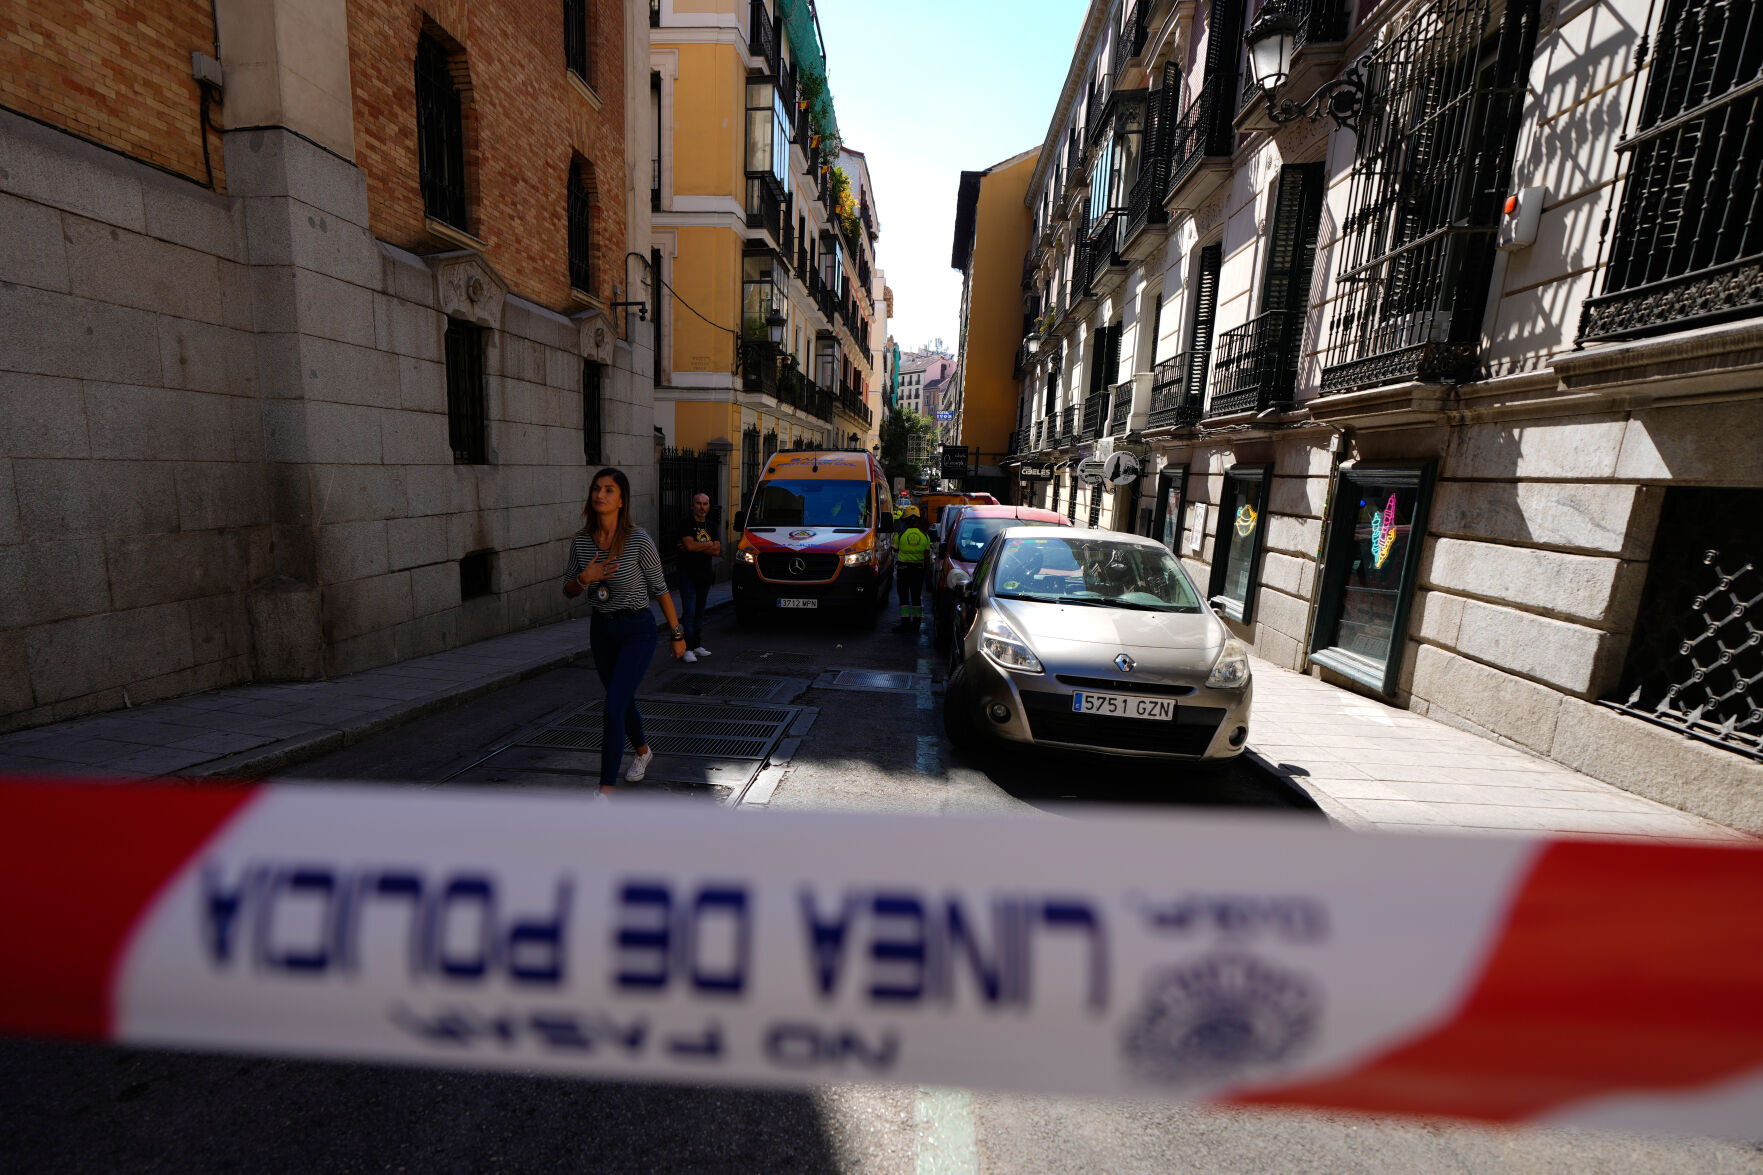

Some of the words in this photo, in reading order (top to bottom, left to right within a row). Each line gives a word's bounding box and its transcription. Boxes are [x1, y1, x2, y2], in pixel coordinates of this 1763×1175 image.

[1085, 695, 1127, 714] 5751
[1136, 700, 1170, 717] GZN
[201, 865, 574, 988] POLICIA
[613, 880, 751, 993] DE
[796, 888, 1112, 1010] LINEA
[763, 1020, 901, 1072] NO
